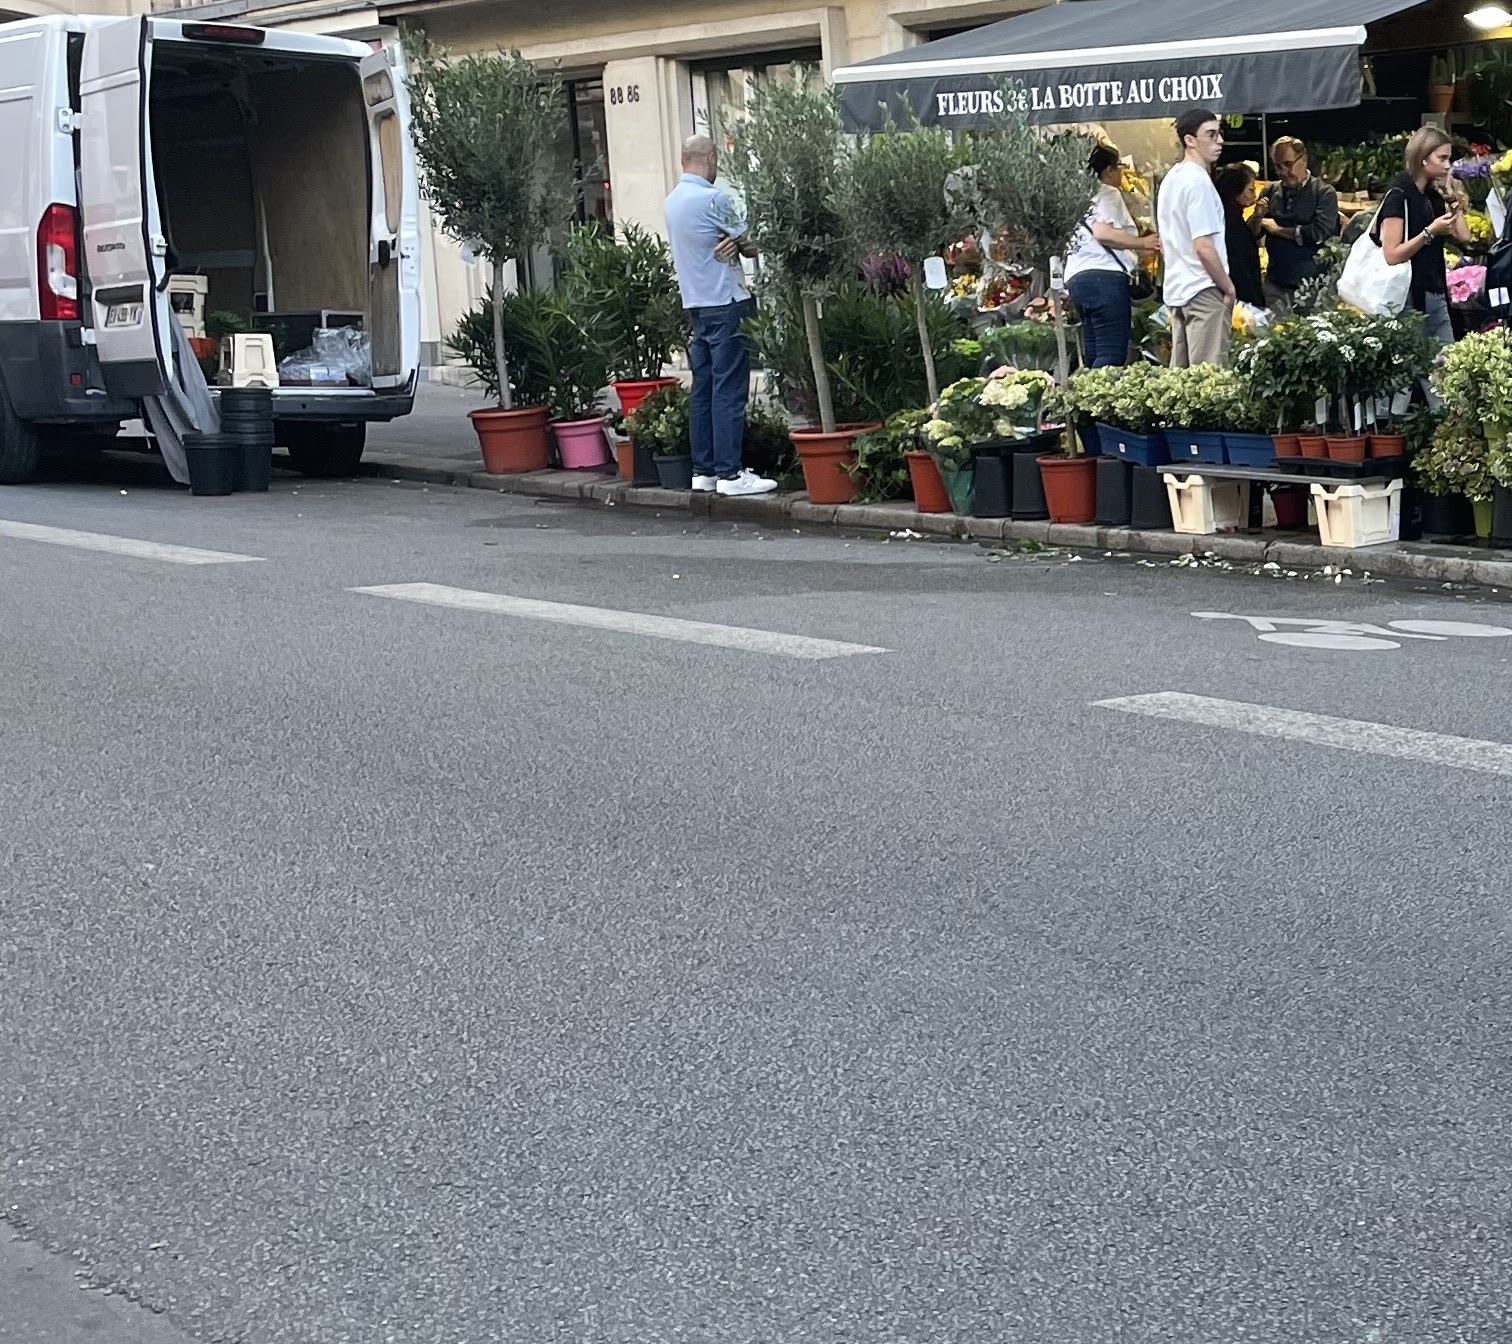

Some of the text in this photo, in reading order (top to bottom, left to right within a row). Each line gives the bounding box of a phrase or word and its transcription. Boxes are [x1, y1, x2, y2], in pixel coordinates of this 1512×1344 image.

[610, 85, 640, 105] 88 86
[936, 89, 1004, 116] FLEURS
[1031, 86, 1056, 111] LA
[1058, 80, 1123, 108] BOTTE
[1129, 78, 1155, 104] AU
[1158, 73, 1224, 102] CHOIX
